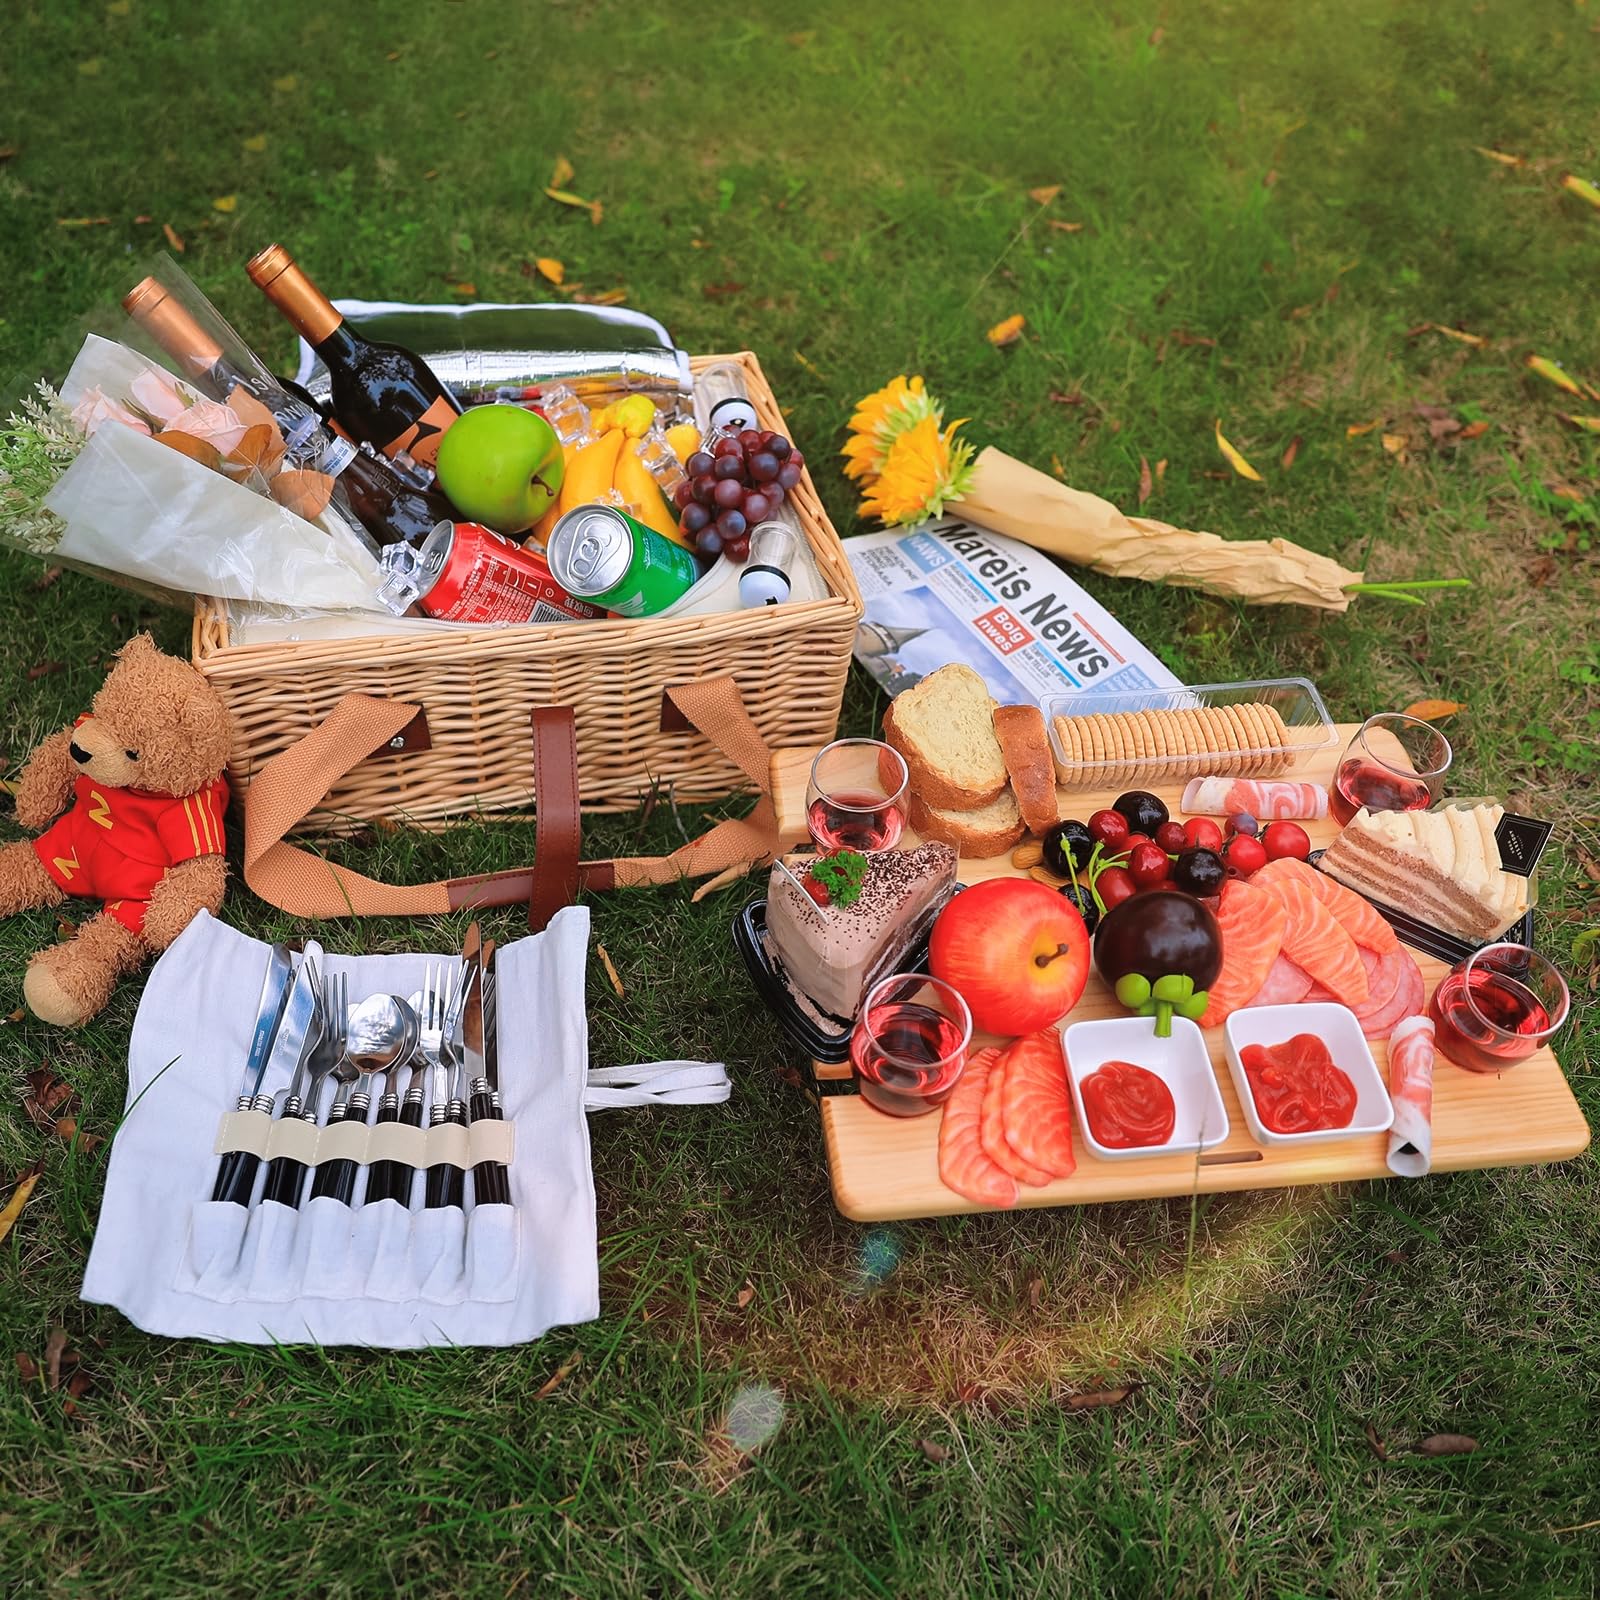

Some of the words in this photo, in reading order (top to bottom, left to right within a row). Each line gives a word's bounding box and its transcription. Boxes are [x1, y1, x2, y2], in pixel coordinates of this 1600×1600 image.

[906, 535, 946, 567] NAWS
[933, 523, 1031, 600] Mareis
[1020, 593, 1109, 677] News
[978, 619, 1012, 651] nwes
[993, 611, 1025, 643] Bolg
